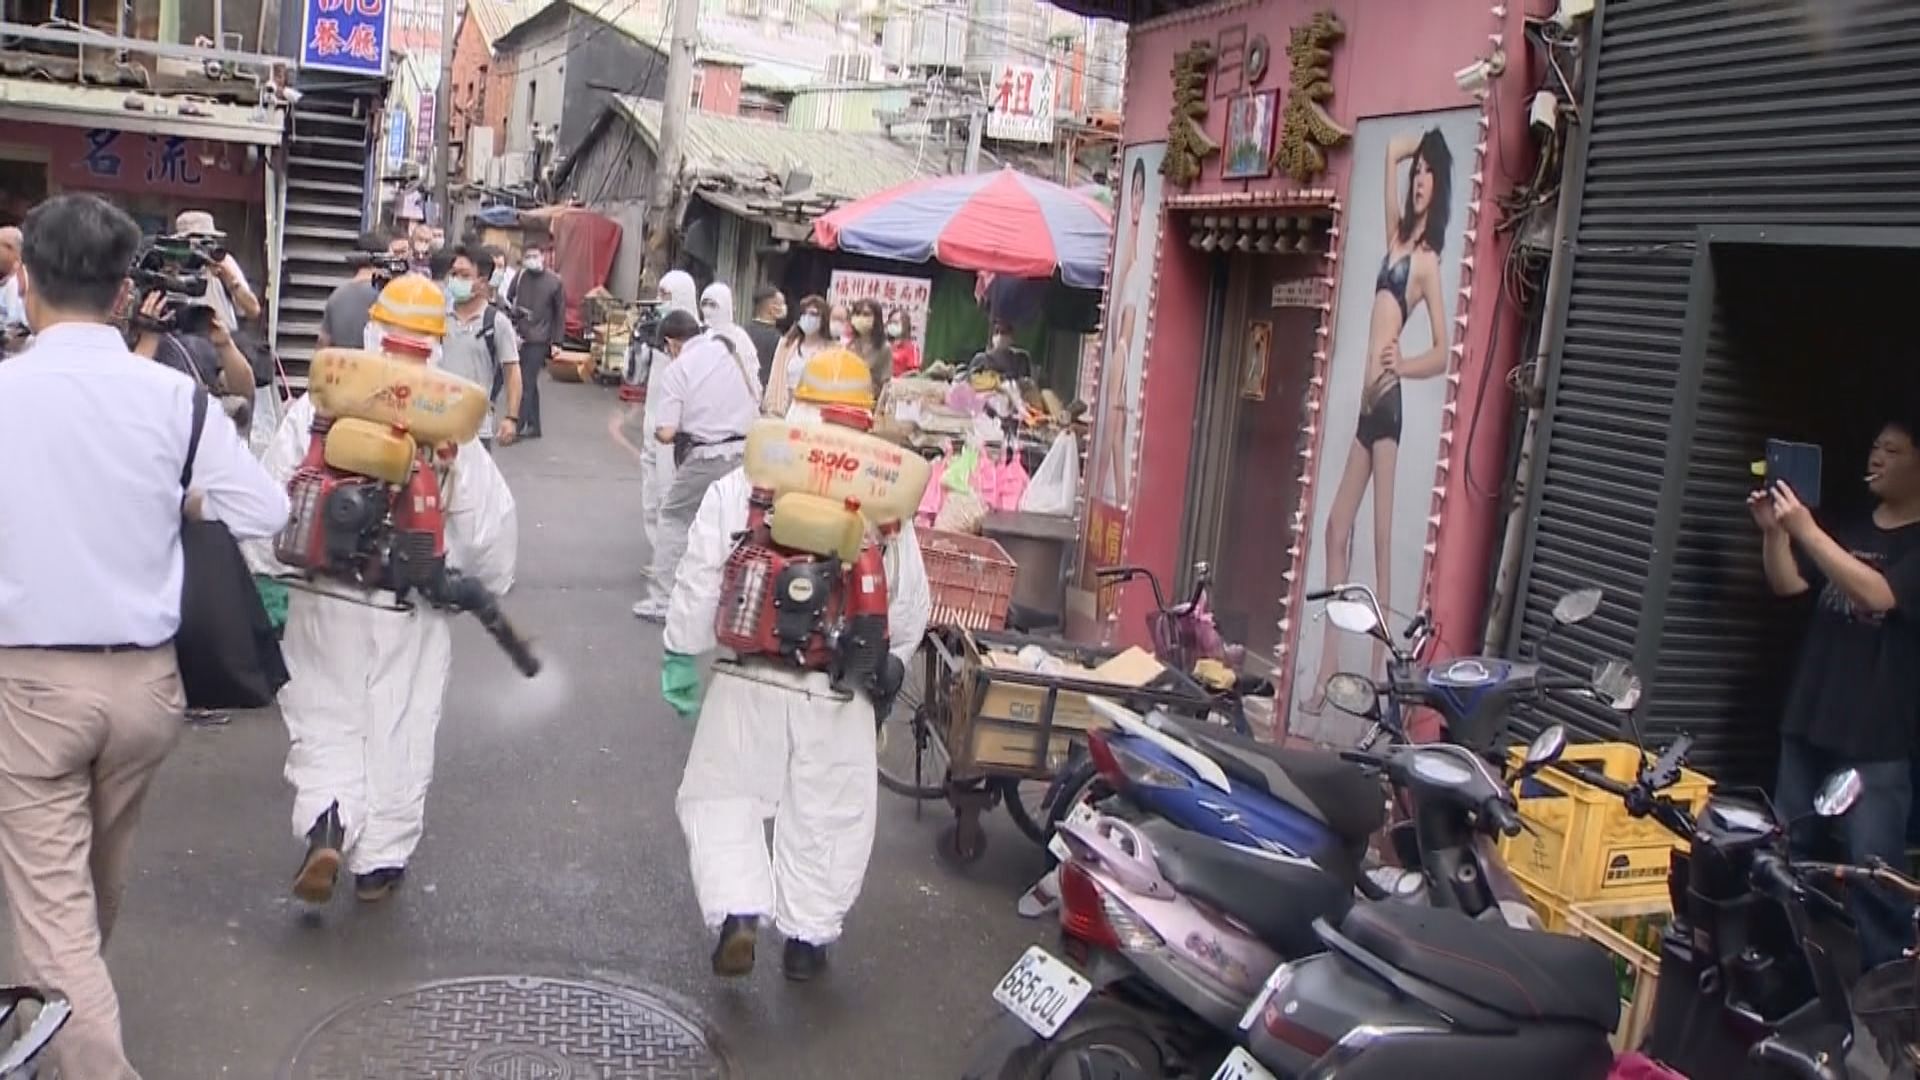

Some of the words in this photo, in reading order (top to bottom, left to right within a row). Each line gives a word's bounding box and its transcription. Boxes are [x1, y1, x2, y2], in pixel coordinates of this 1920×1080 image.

[993, 65, 1034, 116] 租
[1274, 11, 1352, 180] 美
[83, 127, 201, 184] 名流
[807, 448, 860, 471] solo
